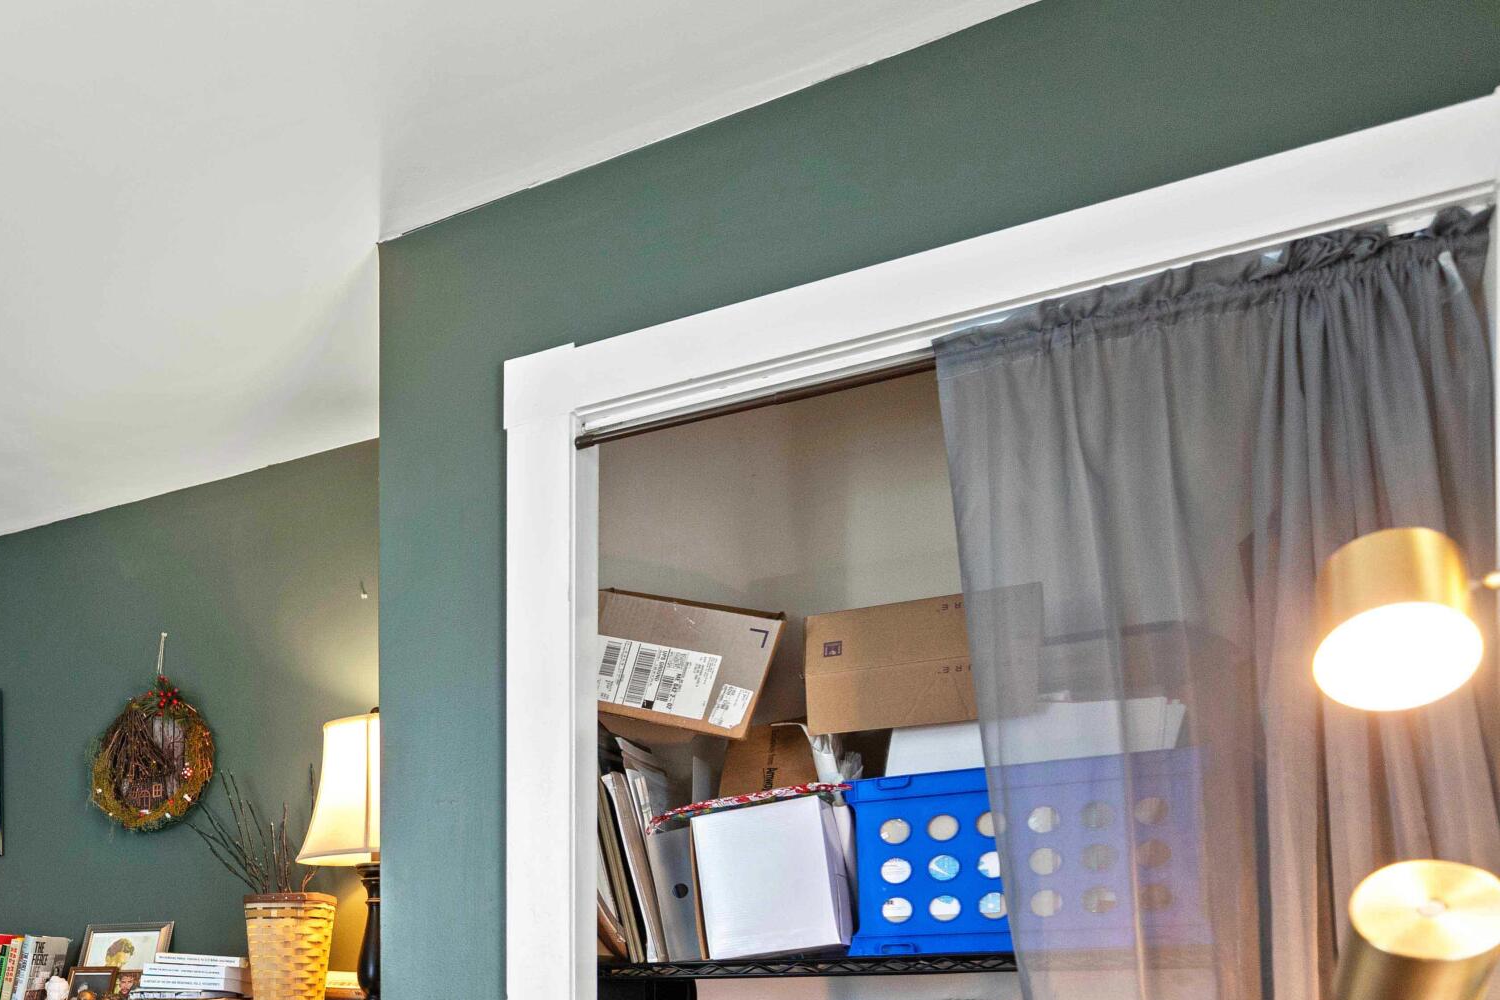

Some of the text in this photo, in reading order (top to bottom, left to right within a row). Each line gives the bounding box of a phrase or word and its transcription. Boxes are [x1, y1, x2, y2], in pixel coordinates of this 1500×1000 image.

[654, 650, 668, 682] UPS GROUND
[34, 942, 46, 953] THE
